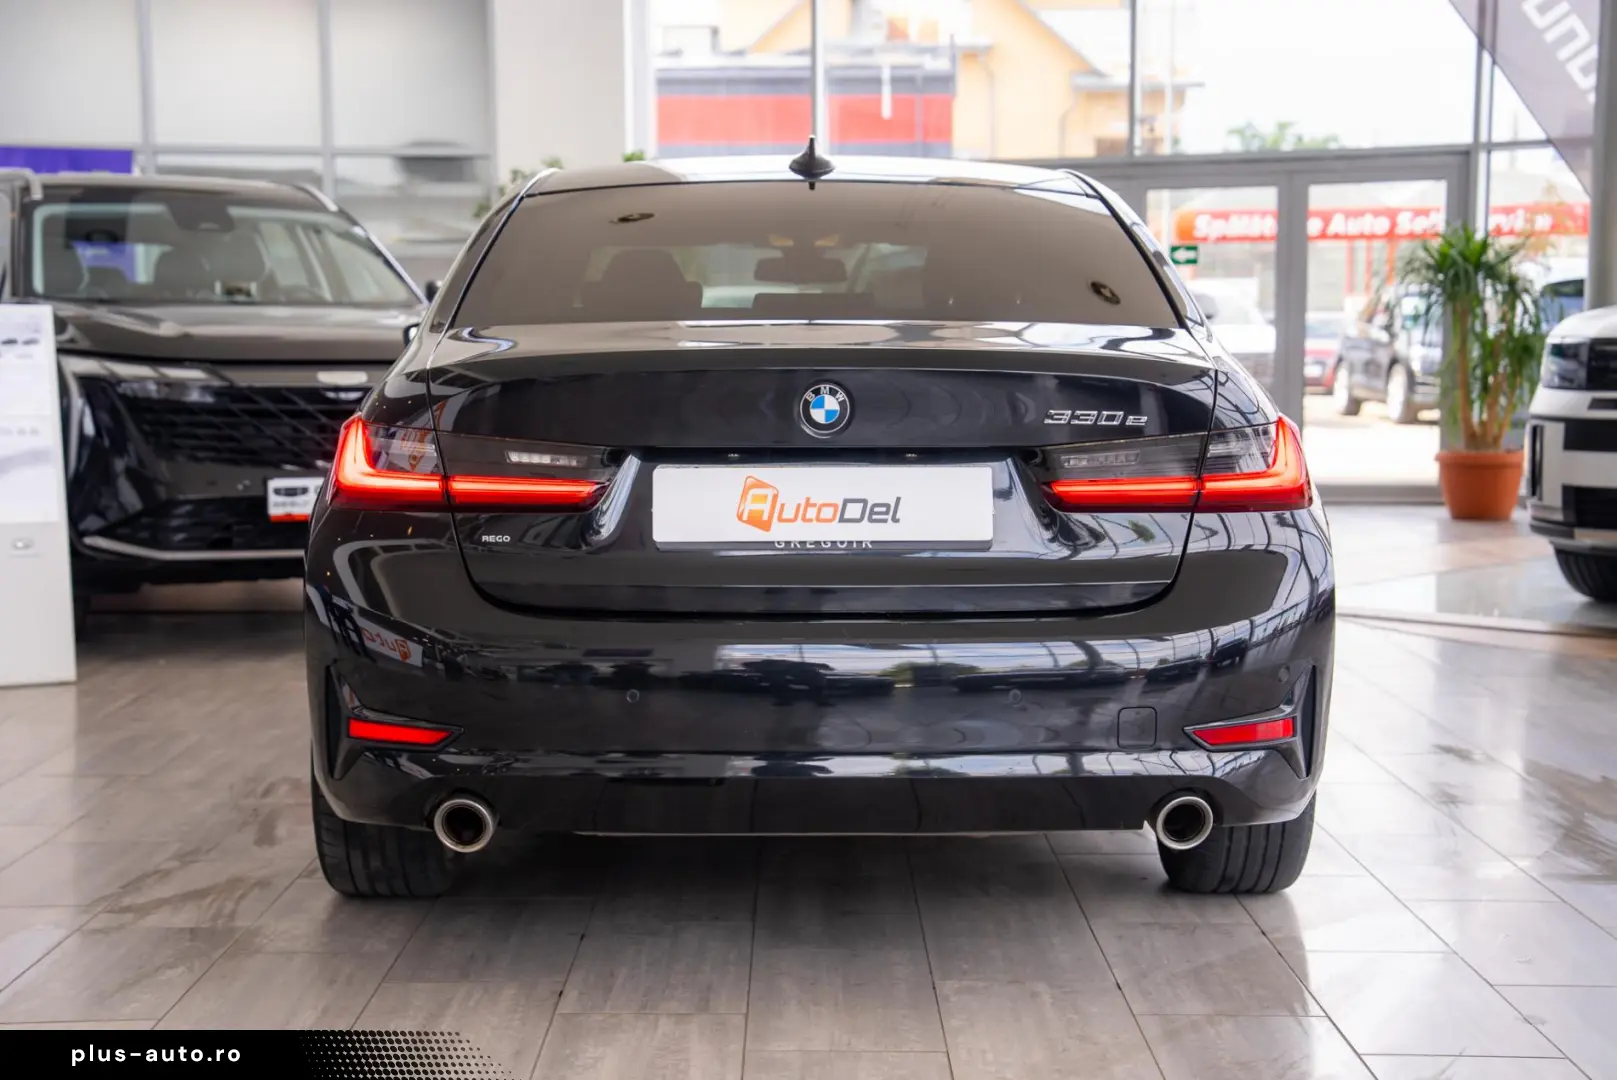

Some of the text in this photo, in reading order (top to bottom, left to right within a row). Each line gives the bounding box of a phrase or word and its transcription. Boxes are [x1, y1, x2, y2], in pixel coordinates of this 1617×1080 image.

[1326, 212, 1390, 236] Auto
[806, 386, 845, 402] BMW
[1044, 409, 1148, 426] 330e
[736, 475, 902, 532] AutoDel
